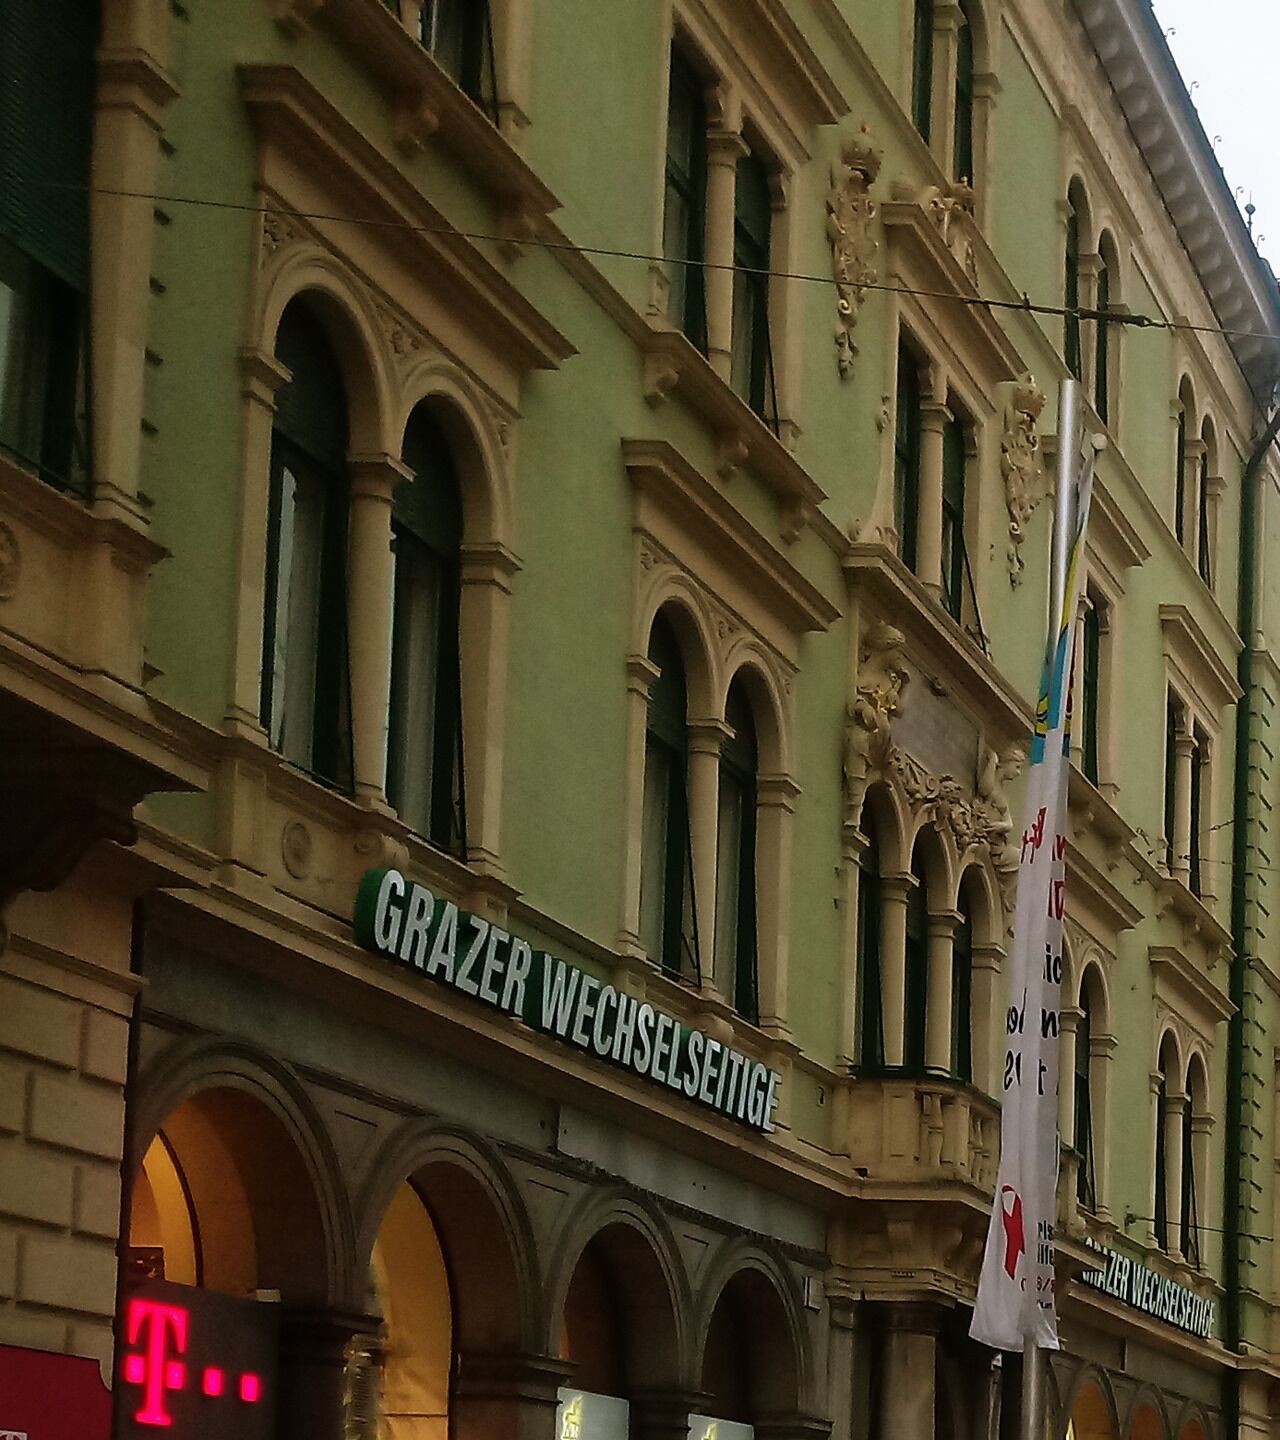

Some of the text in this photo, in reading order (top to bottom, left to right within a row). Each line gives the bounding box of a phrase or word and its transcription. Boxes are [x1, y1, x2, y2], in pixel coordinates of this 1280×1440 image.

[373, 868, 782, 1134] GRAZER WECHSELSEITIGE
[1131, 1259, 1217, 1339] WECHSELSEITIGE
